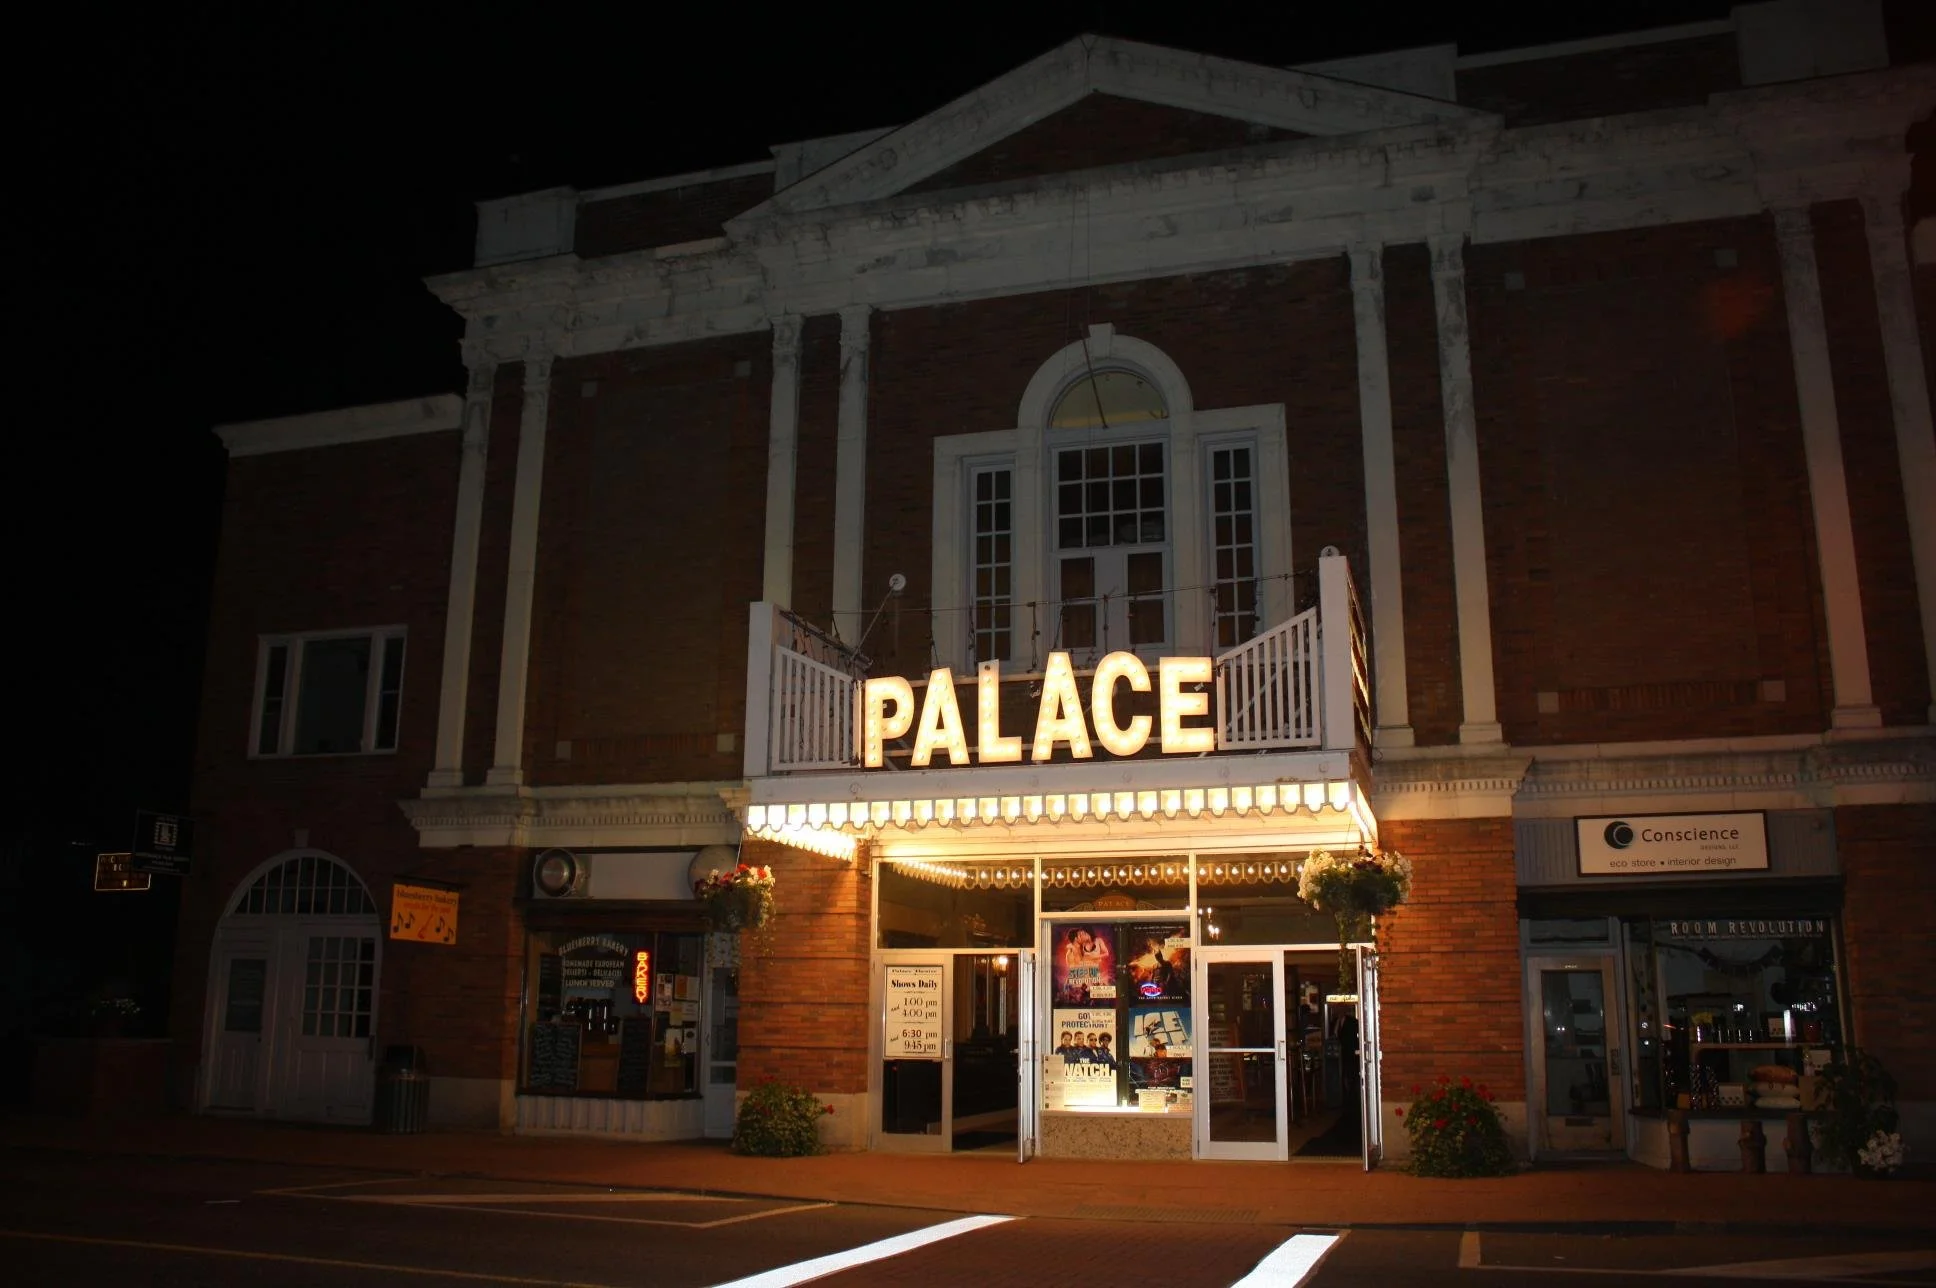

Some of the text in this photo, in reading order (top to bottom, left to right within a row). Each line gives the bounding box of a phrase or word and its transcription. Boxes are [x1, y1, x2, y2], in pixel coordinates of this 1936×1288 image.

[865, 651, 1214, 768] PALACE
[1641, 827, 1739, 842] Conscience
[1609, 856, 1736, 868] eco store interior design
[1670, 919, 1824, 935] ROOM REVOLUTION
[636, 951, 649, 1003] BAKERY
[891, 979, 937, 990] Shows Daily
[925, 1000, 938, 1008] pm
[925, 1011, 937, 1019] pm
[902, 1029, 938, 1040] 6:30 pm
[923, 1042, 936, 1052] pm
